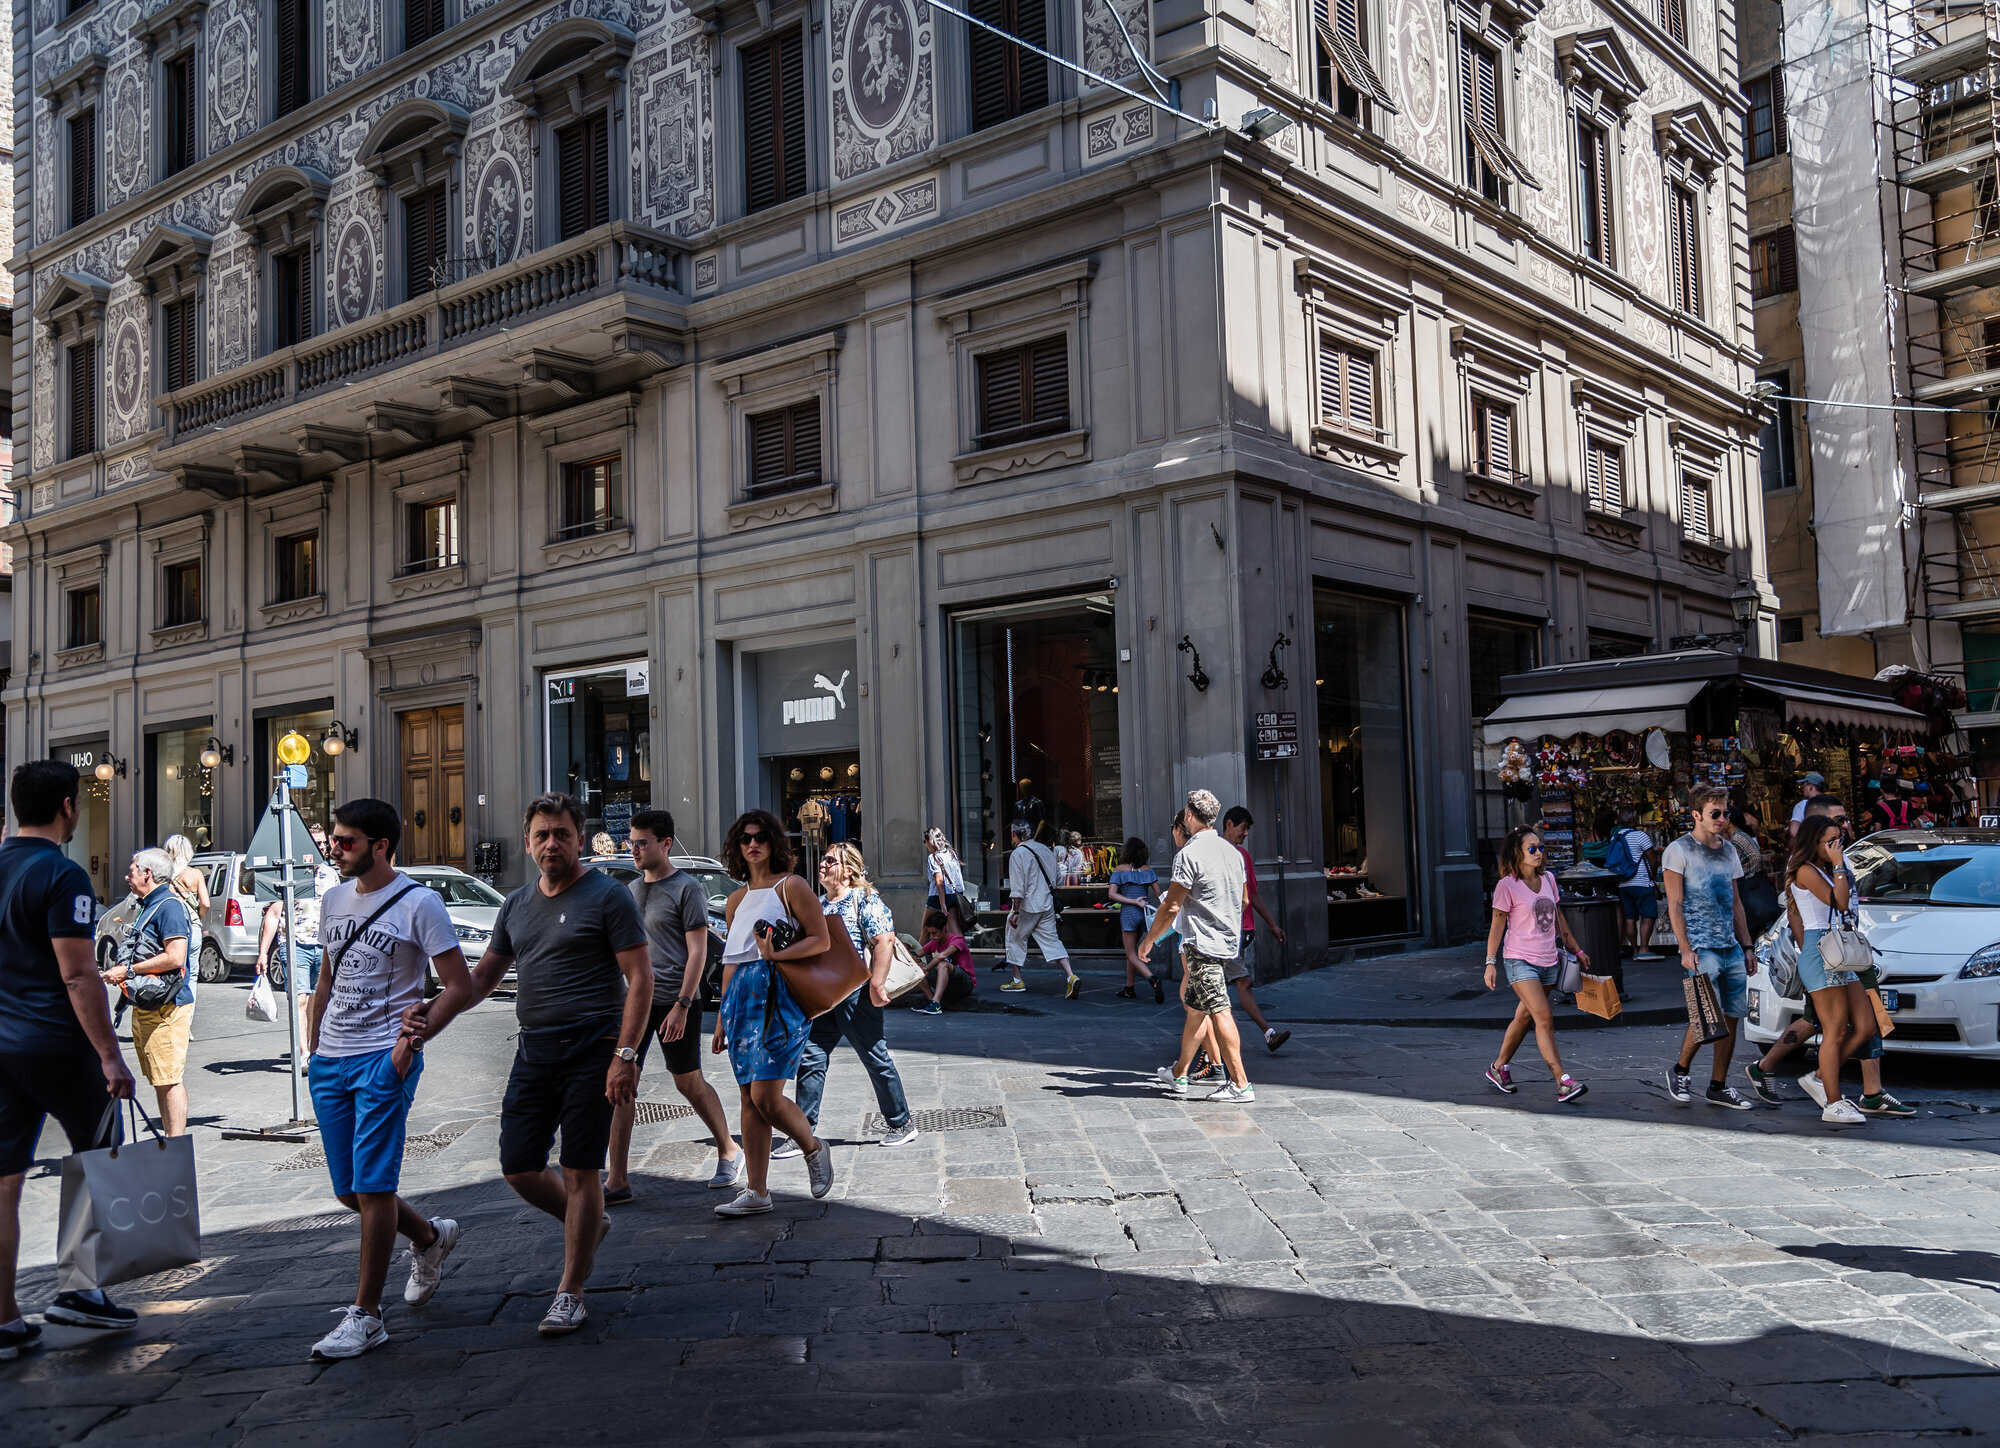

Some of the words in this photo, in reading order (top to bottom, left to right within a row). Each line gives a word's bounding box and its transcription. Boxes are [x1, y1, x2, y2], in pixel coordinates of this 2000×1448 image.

[783, 696, 836, 725] PUMA
[616, 746, 622, 765] 9
[73, 894, 92, 924] 8
[107, 1185, 190, 1232] COS
